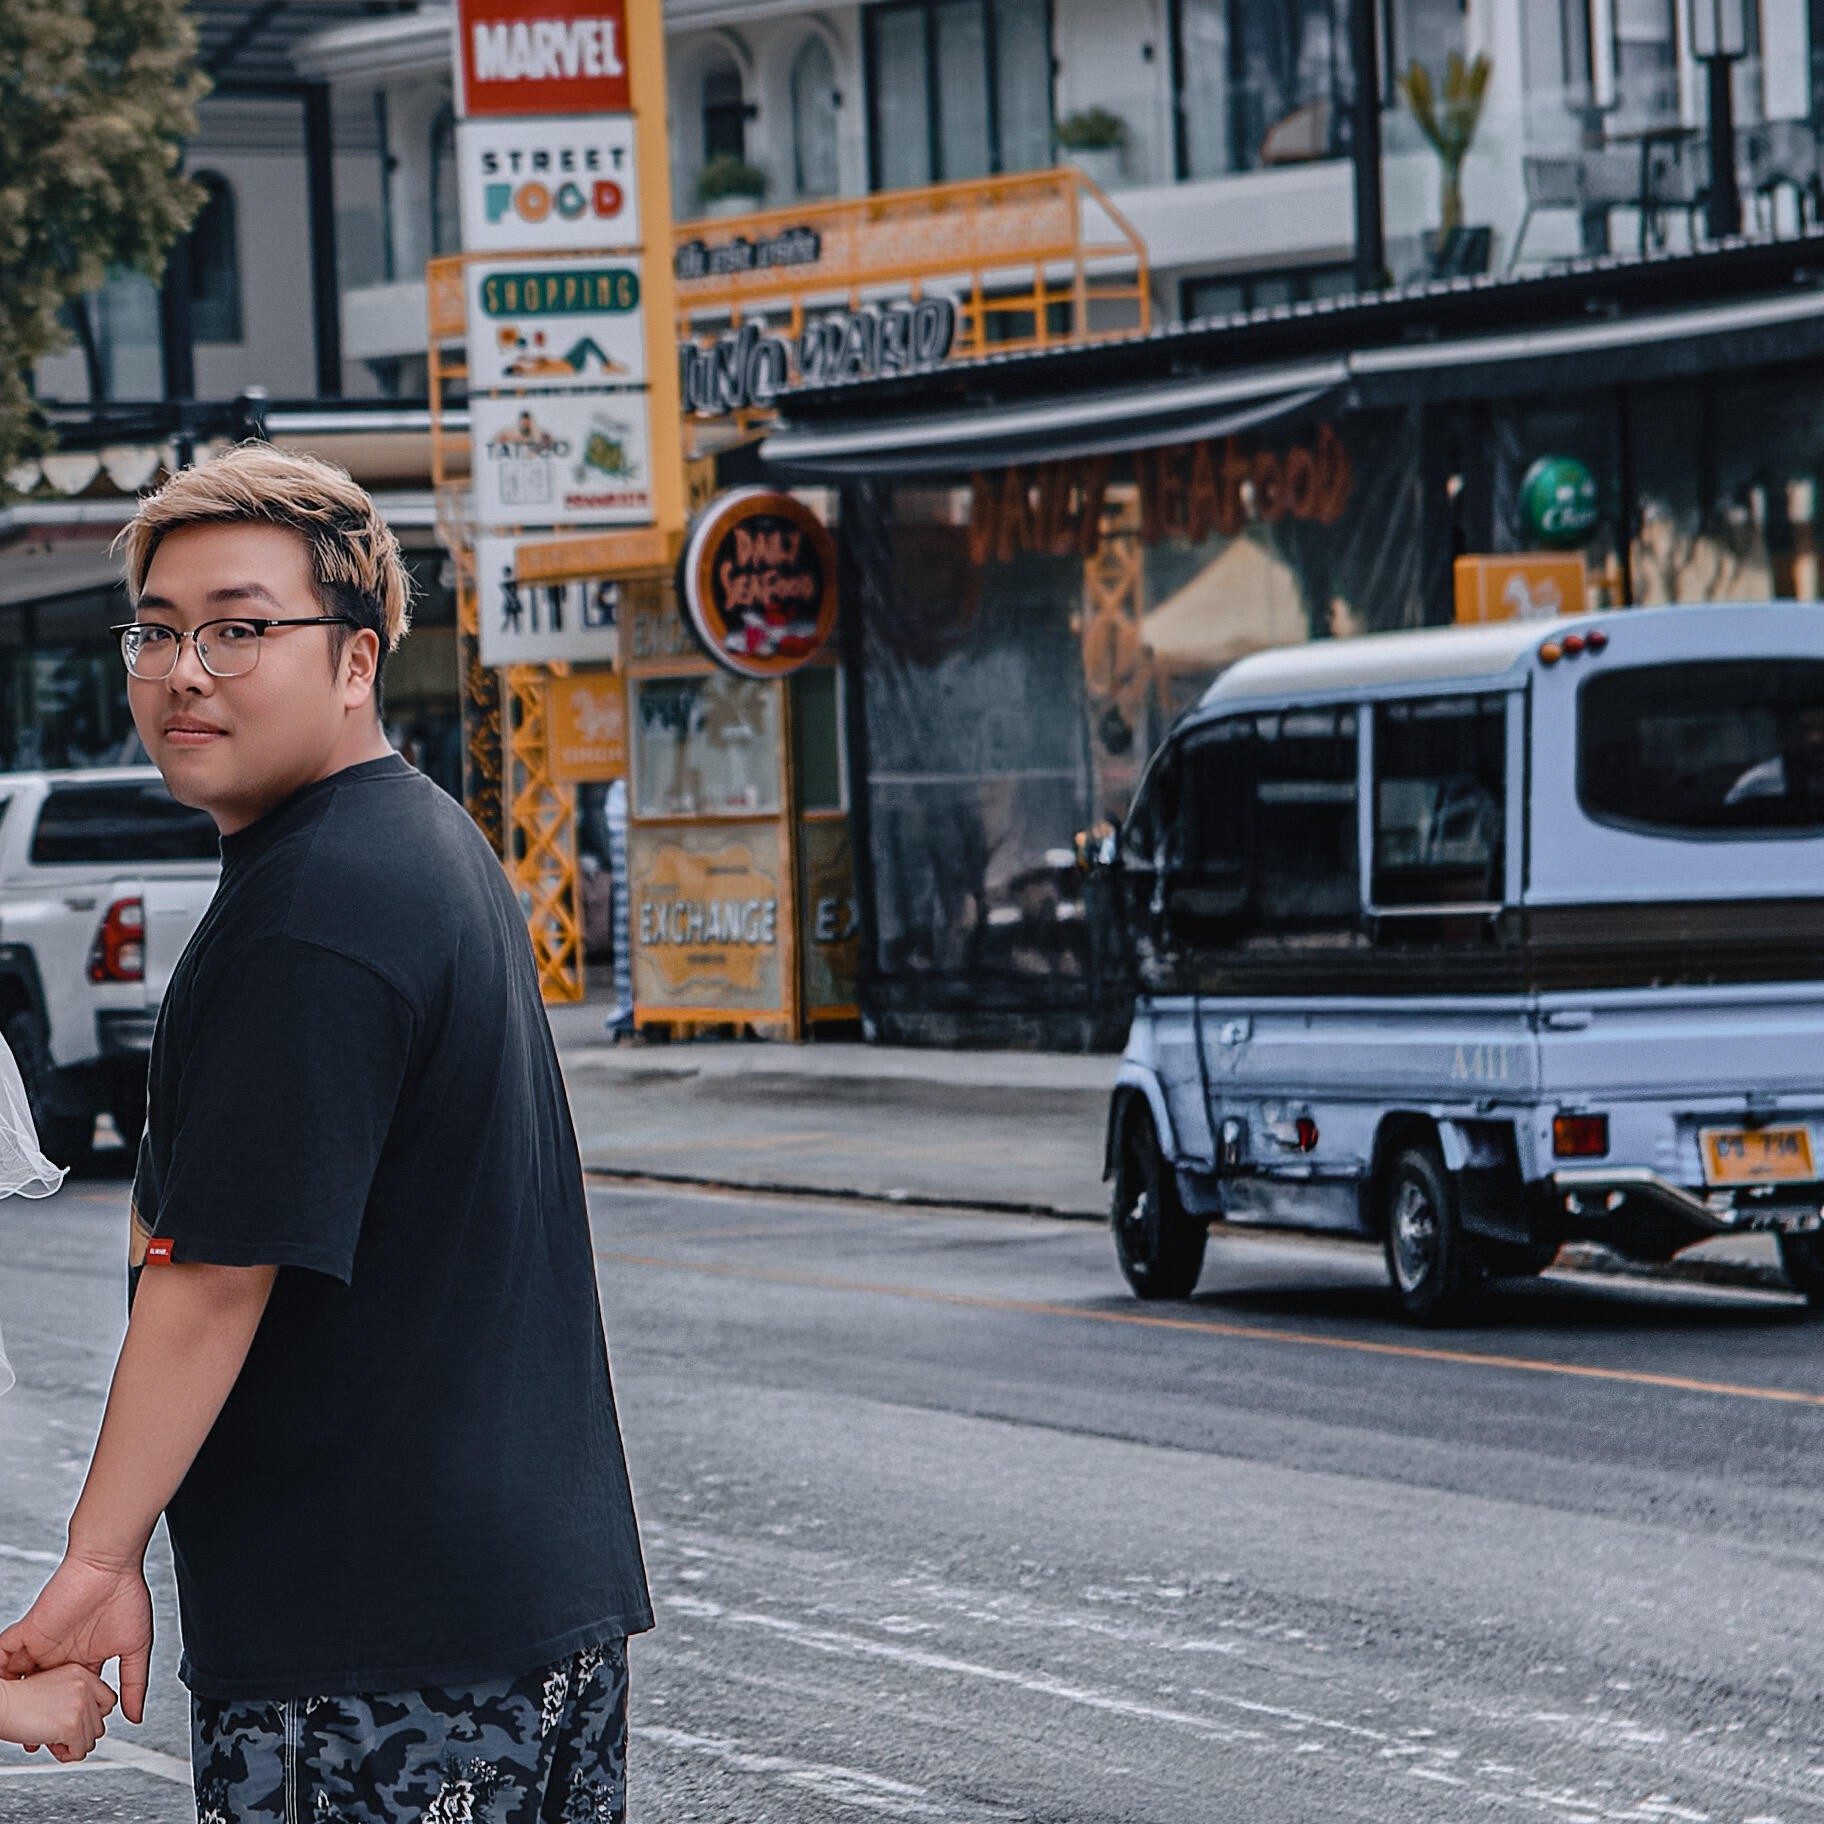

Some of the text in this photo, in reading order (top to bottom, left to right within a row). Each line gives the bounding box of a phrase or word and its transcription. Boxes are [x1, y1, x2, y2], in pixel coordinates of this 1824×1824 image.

[473, 19, 624, 81] MARVEL
[482, 147, 625, 175] STREET
[484, 179, 624, 224] FOOD
[486, 275, 633, 313] SHOPPING
[638, 895, 777, 947] EXCHANGE
